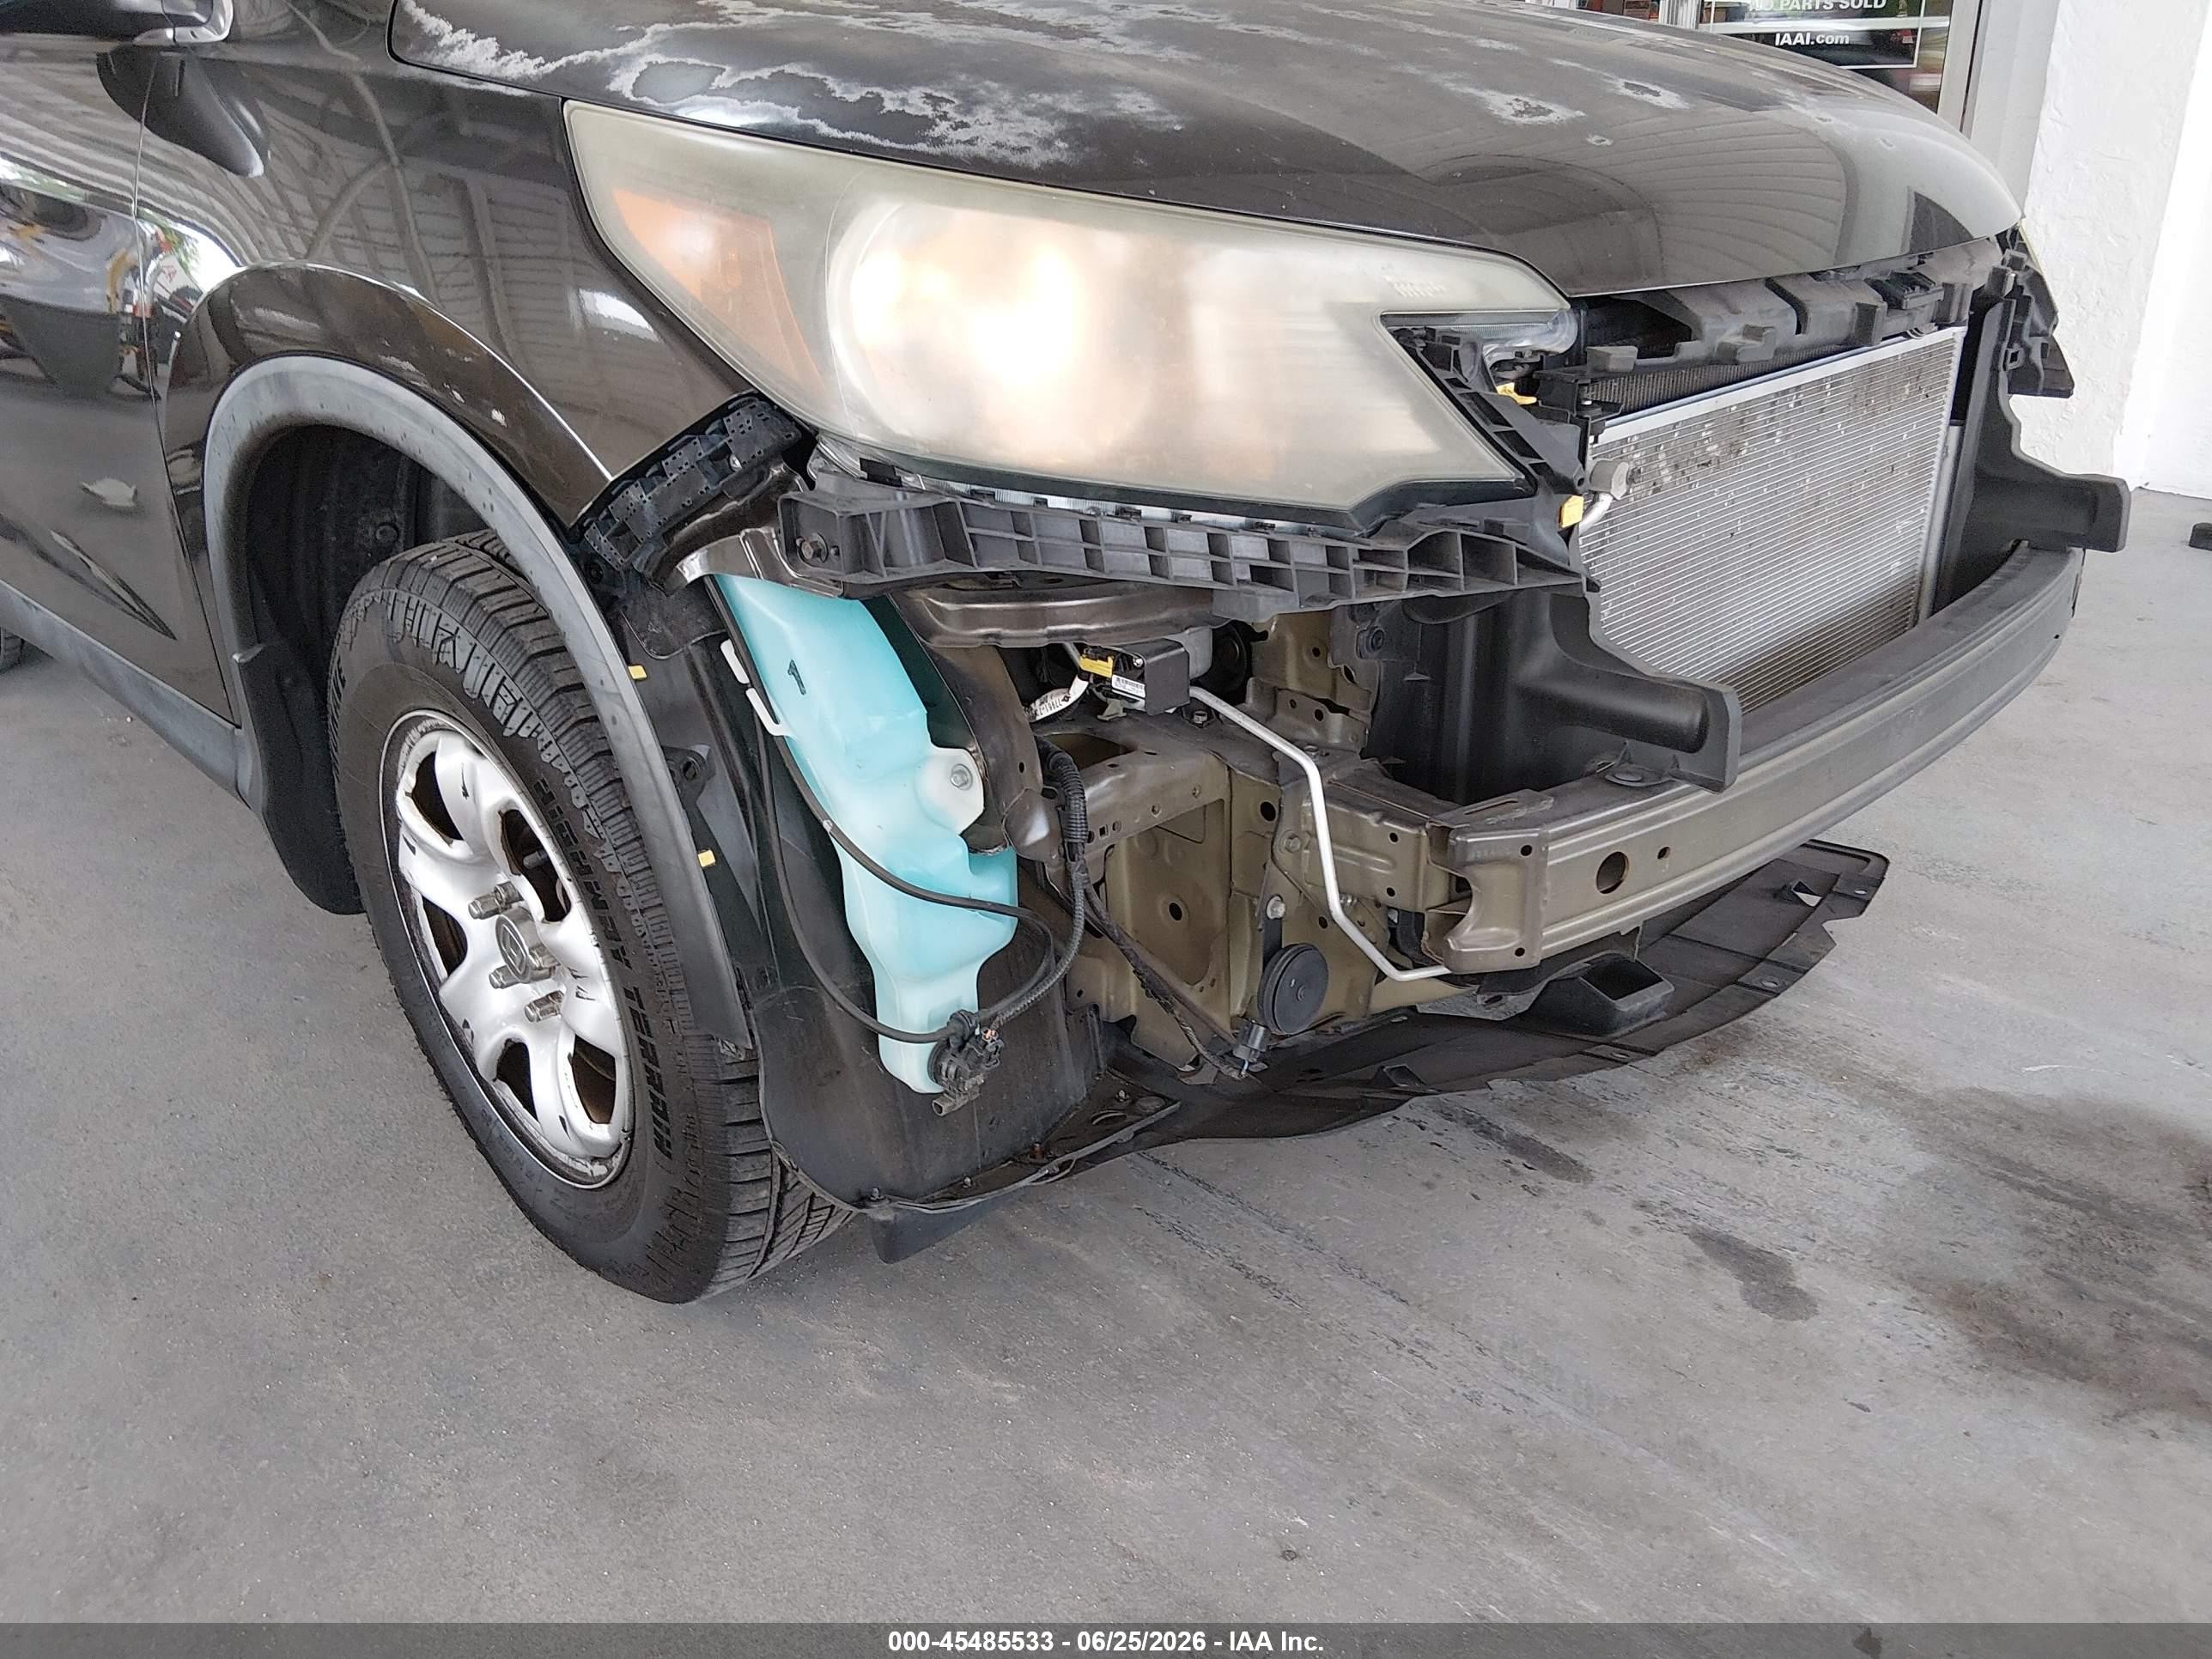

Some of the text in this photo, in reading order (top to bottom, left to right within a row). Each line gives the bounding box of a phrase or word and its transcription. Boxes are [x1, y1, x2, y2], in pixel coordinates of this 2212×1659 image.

[1779, 0, 1834, 10] PARTS
[1838, 0, 1887, 9] SOLD
[1774, 32, 1850, 46] IAAI.com
[623, 984, 674, 1162] TERRAIN
